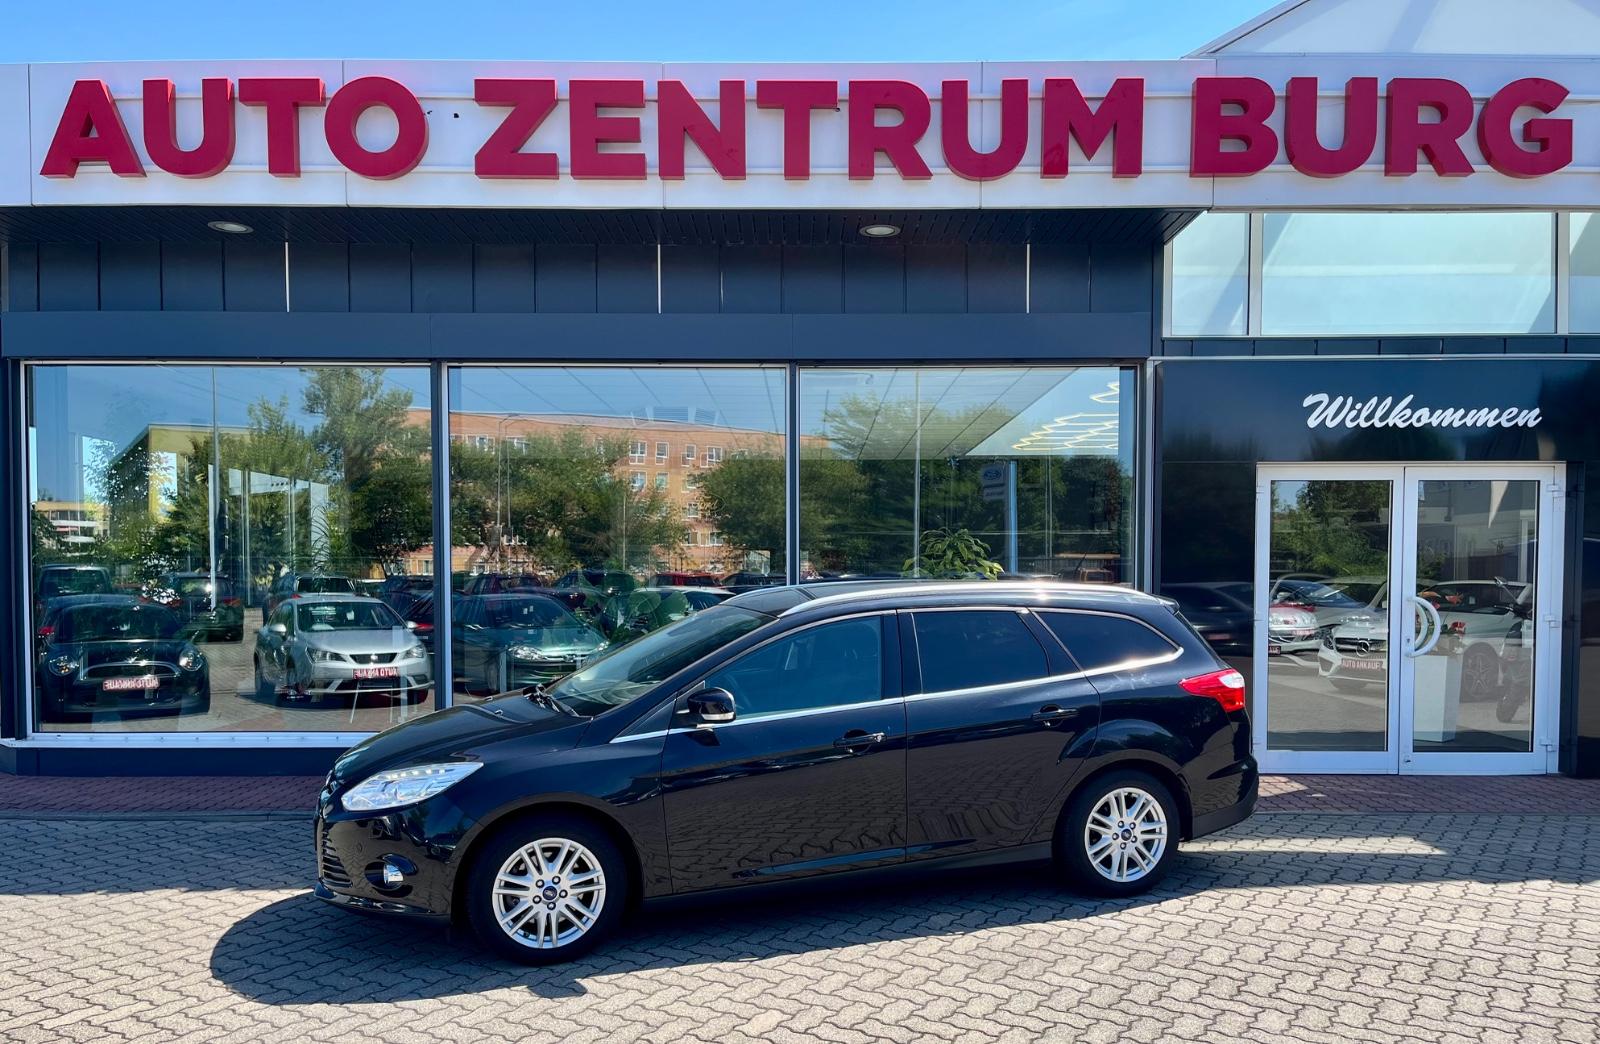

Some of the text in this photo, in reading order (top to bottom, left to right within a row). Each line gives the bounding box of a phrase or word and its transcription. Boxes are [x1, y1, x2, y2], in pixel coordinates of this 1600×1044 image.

[41, 76, 1574, 180] AUTO ZENTRUM BURG
[1302, 393, 1542, 428] Willkommen
